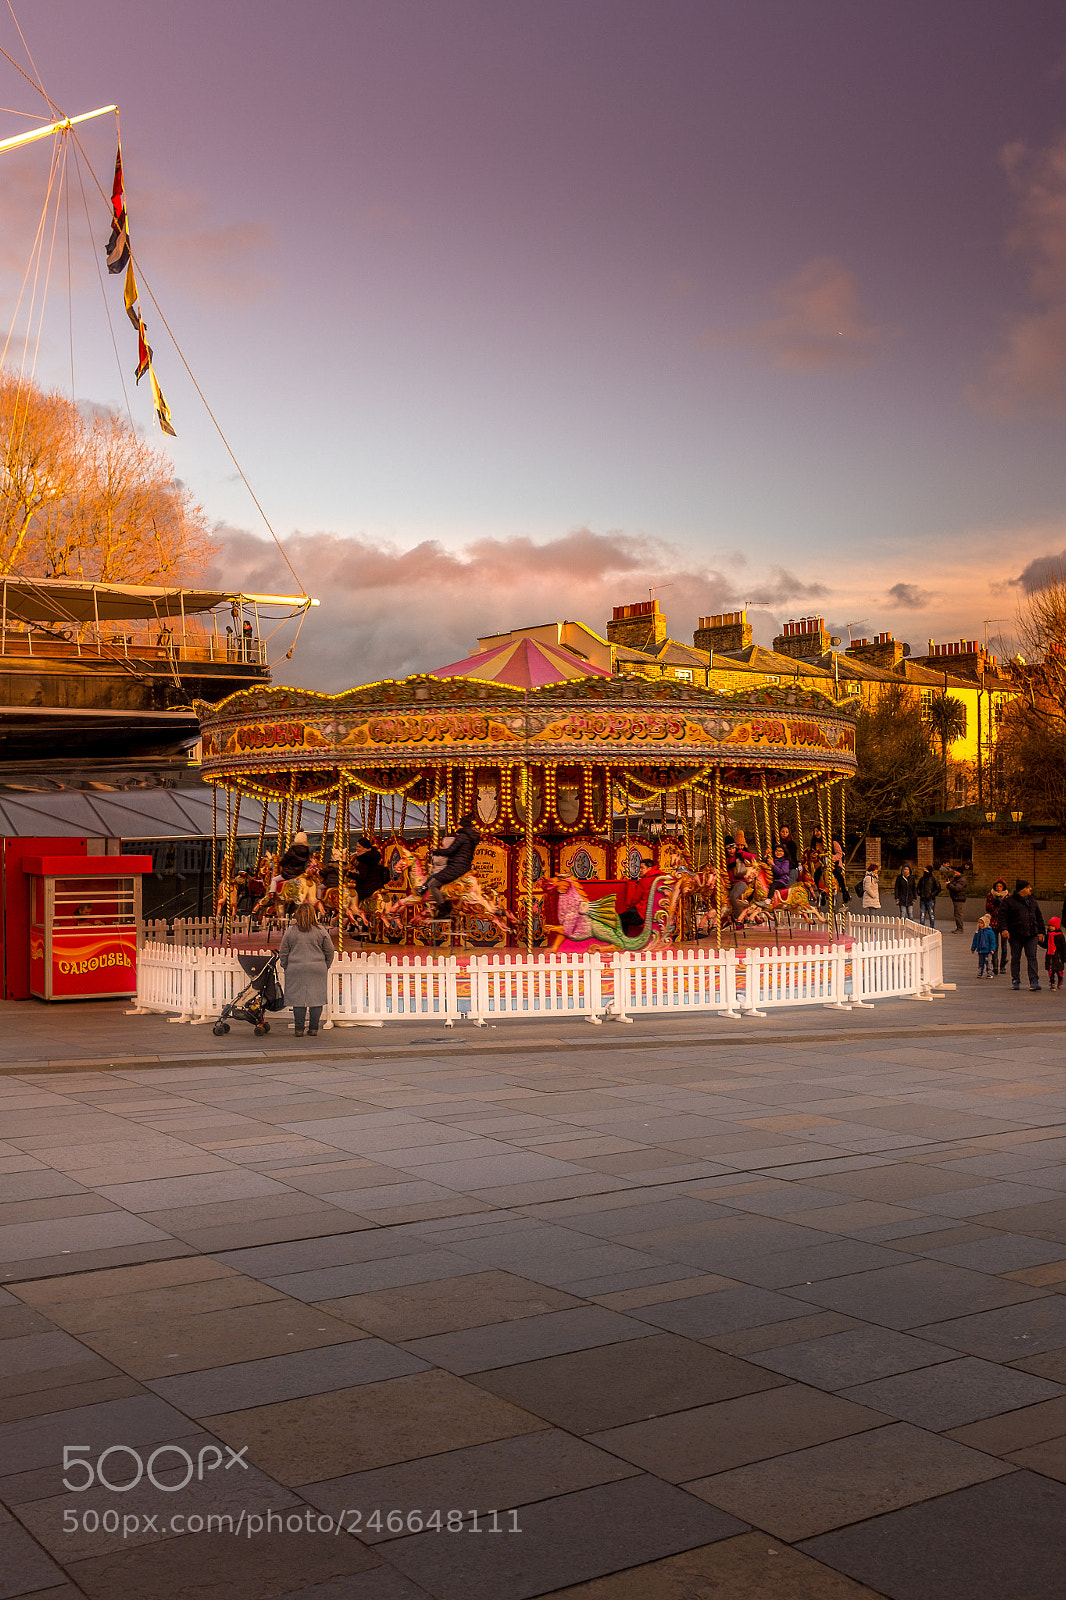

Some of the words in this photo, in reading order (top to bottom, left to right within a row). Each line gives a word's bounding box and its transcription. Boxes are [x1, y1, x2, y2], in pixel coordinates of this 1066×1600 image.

[237, 723, 305, 750] GOLDEN
[368, 716, 489, 744] GALLOPING
[563, 714, 687, 740] HORSES
[474, 848, 496, 857] OTICE
[58, 952, 132, 975] CAROUSEL
